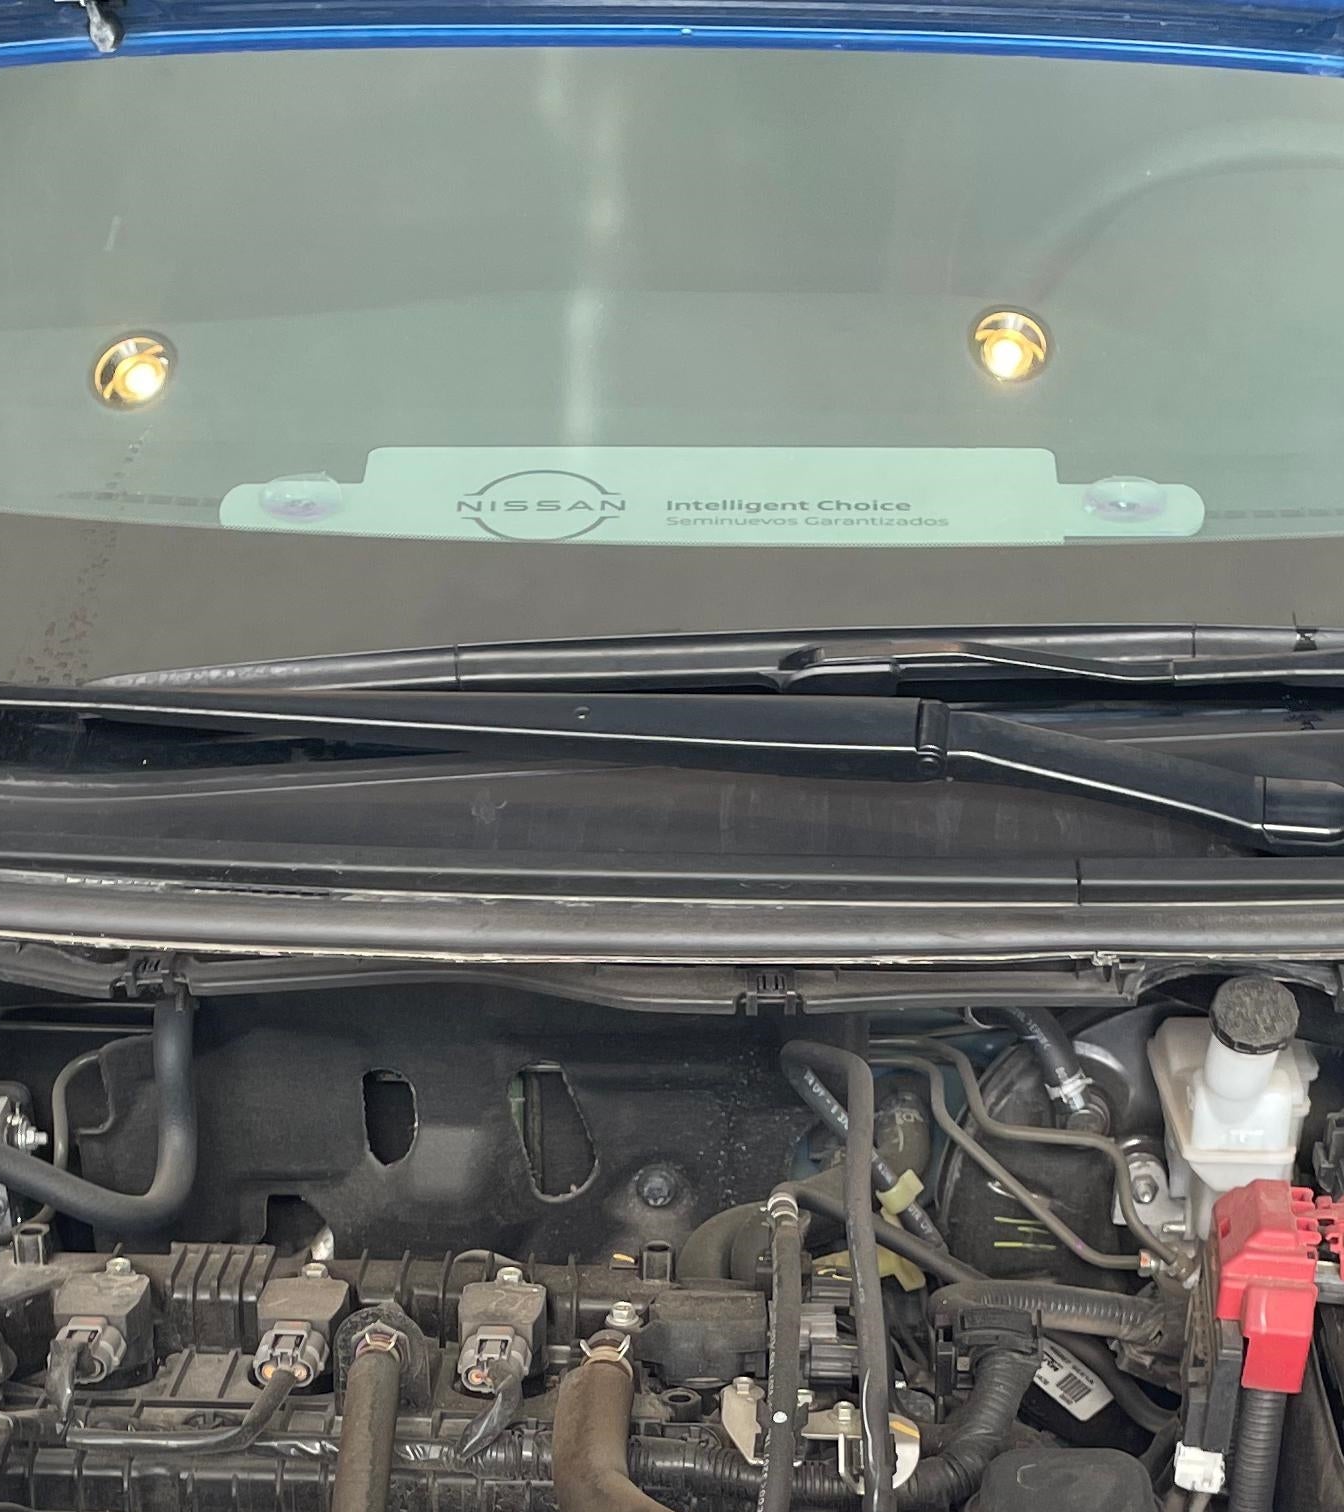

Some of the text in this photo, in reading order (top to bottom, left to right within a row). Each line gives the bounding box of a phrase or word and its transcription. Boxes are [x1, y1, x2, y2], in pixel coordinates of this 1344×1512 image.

[456, 500, 626, 512] NISSAN
[666, 500, 912, 514] Intelligent Choice
[666, 516, 950, 527] Seminuevos Garantizados
